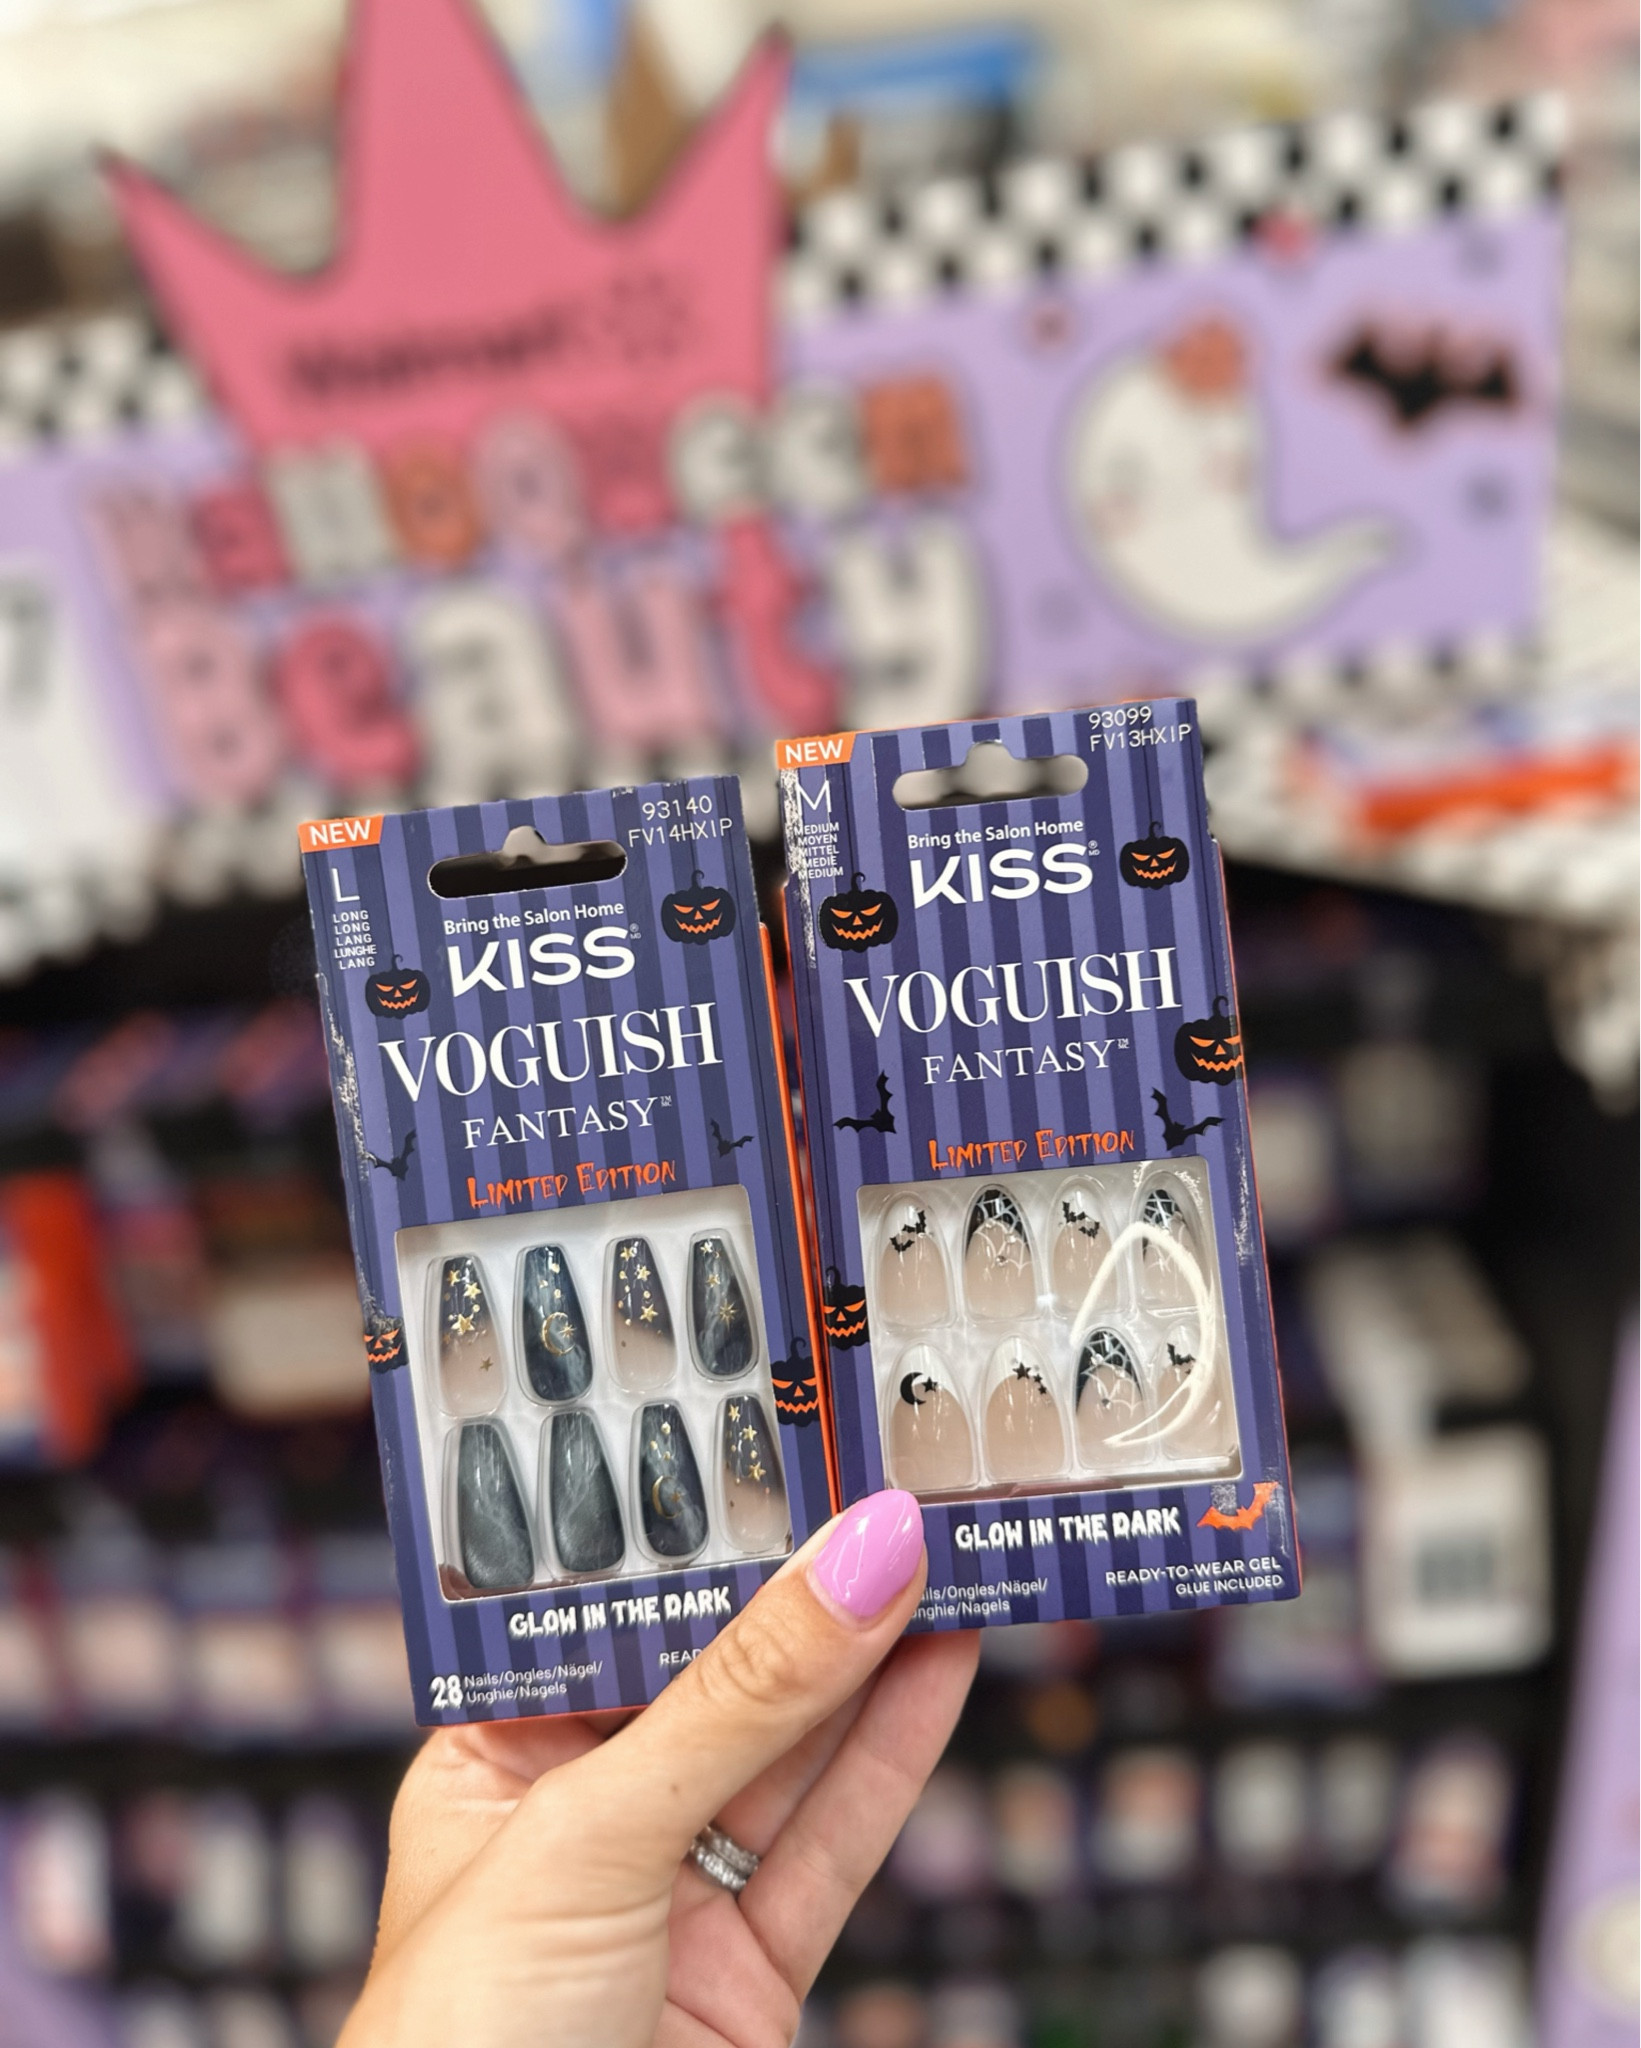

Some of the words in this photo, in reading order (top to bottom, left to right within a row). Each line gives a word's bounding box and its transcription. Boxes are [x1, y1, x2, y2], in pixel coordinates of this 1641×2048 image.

[1088, 706, 1152, 730] 93099
[785, 739, 843, 764] NEW
[642, 795, 712, 820] 93140
[795, 780, 832, 816] M
[309, 818, 371, 846] NEW
[794, 822, 840, 835] MEDIUM
[798, 834, 838, 846] MOYEN
[907, 833, 951, 849] Bring
[954, 829, 983, 845] the
[985, 824, 1031, 841] Salon
[1034, 820, 1084, 836] Home
[799, 845, 840, 858] MITTEL
[803, 856, 838, 868] MEDIE
[331, 868, 360, 902] L
[798, 866, 843, 879] MEDIUM
[910, 843, 1093, 909] KISS
[333, 910, 369, 923] LONG
[334, 921, 371, 935] LONG
[443, 918, 489, 935] Bring
[492, 913, 521, 929] the
[524, 907, 571, 926] Salon
[574, 902, 624, 920] Home
[334, 944, 378, 959] LUNGHE
[336, 933, 372, 947] LANG
[339, 956, 376, 970] LANG
[447, 926, 636, 998] KISS
[843, 947, 1182, 1038] VOGUISH
[377, 1002, 723, 1102] VOGUISH
[921, 1039, 1116, 1085] FANTASY
[461, 1096, 658, 1149] FANTASY
[928, 1139, 1028, 1172] LIMITED
[1034, 1129, 1135, 1161] EDITION
[466, 1173, 568, 1210] LIMITED
[575, 1159, 677, 1196] EDITION
[955, 1519, 1025, 1551] GLOW
[1027, 1516, 1054, 1545] IN
[1058, 1513, 1108, 1545] THE
[1111, 1507, 1182, 1541] DARK
[1105, 1560, 1245, 1586] READY-TO-WEAR
[1248, 1556, 1281, 1572] GEL
[1175, 1580, 1211, 1597] GLUE
[1213, 1574, 1284, 1593] INCLUDED
[508, 1606, 577, 1640] GLOW
[581, 1602, 608, 1633] IN
[611, 1595, 661, 1629] THE
[663, 1586, 732, 1621] DARK
[659, 1648, 703, 1666] READ
[430, 1674, 464, 1709] 28
[466, 1681, 568, 1704] Unghie/Nagels
